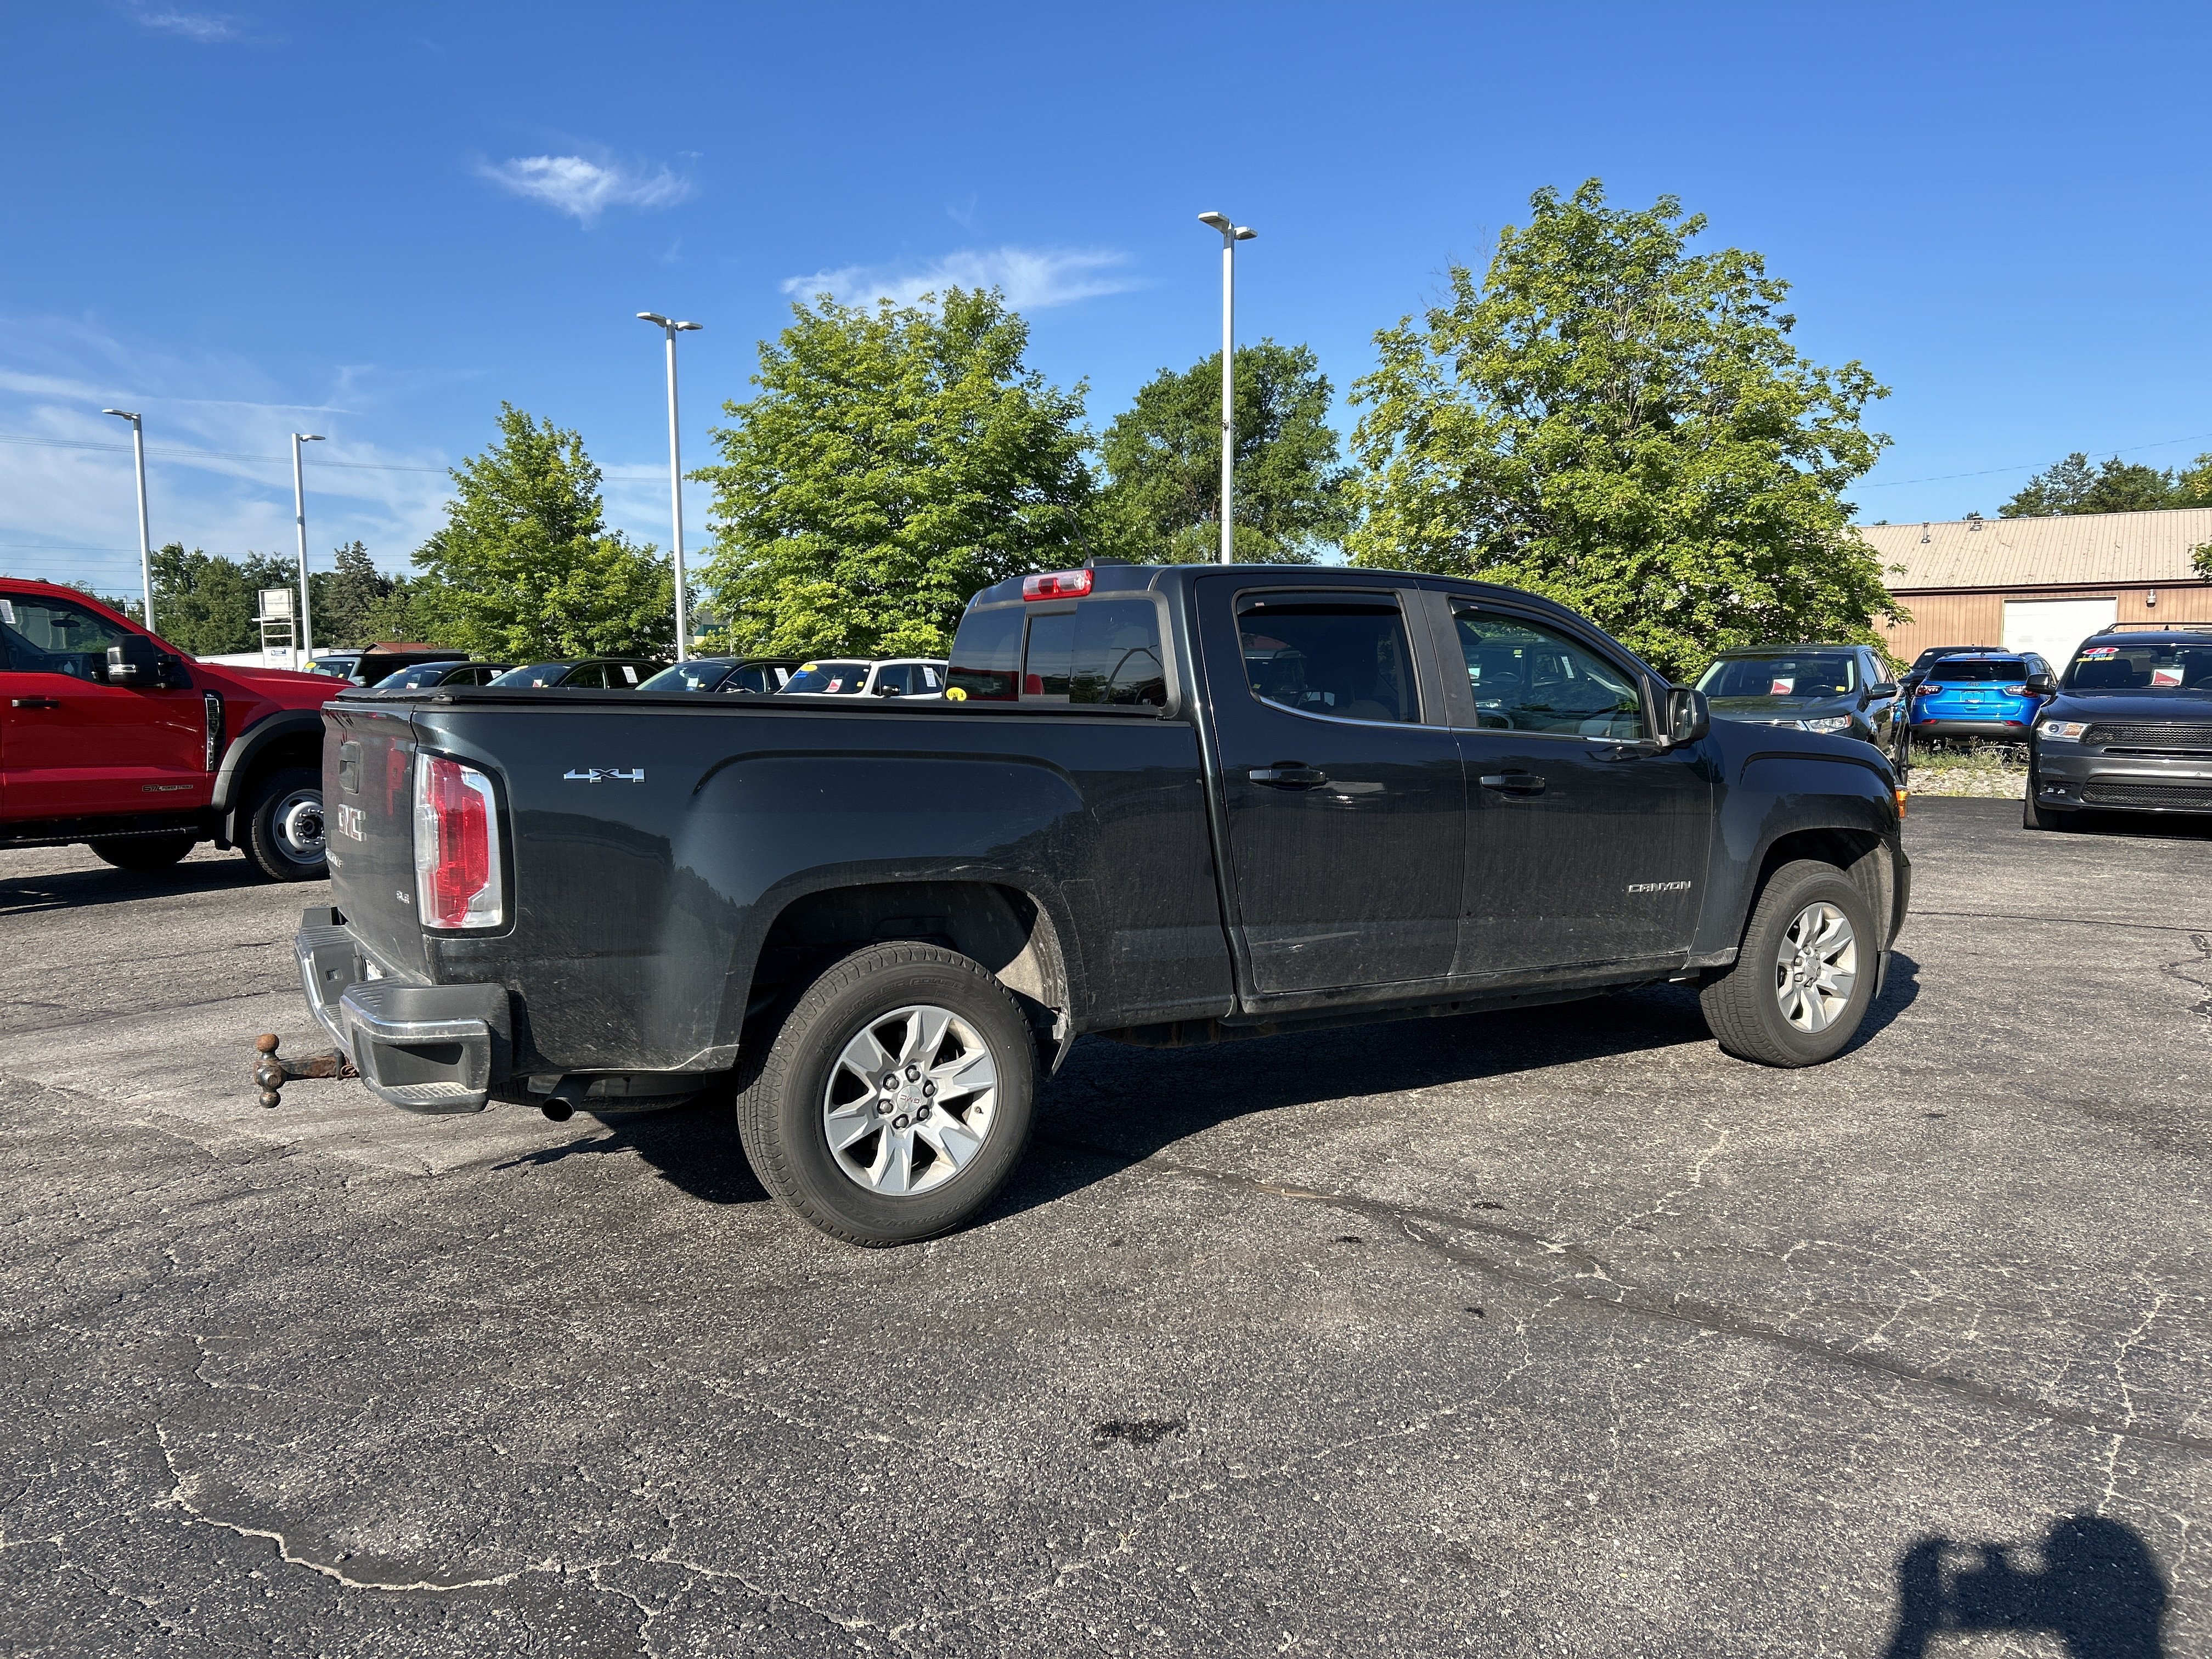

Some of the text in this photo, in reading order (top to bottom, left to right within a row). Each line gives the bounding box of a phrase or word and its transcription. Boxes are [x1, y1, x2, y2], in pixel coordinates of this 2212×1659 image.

[338, 804, 367, 842] GMC
[1628, 881, 1691, 893] CANYON
[900, 1094, 920, 1104] GMC
